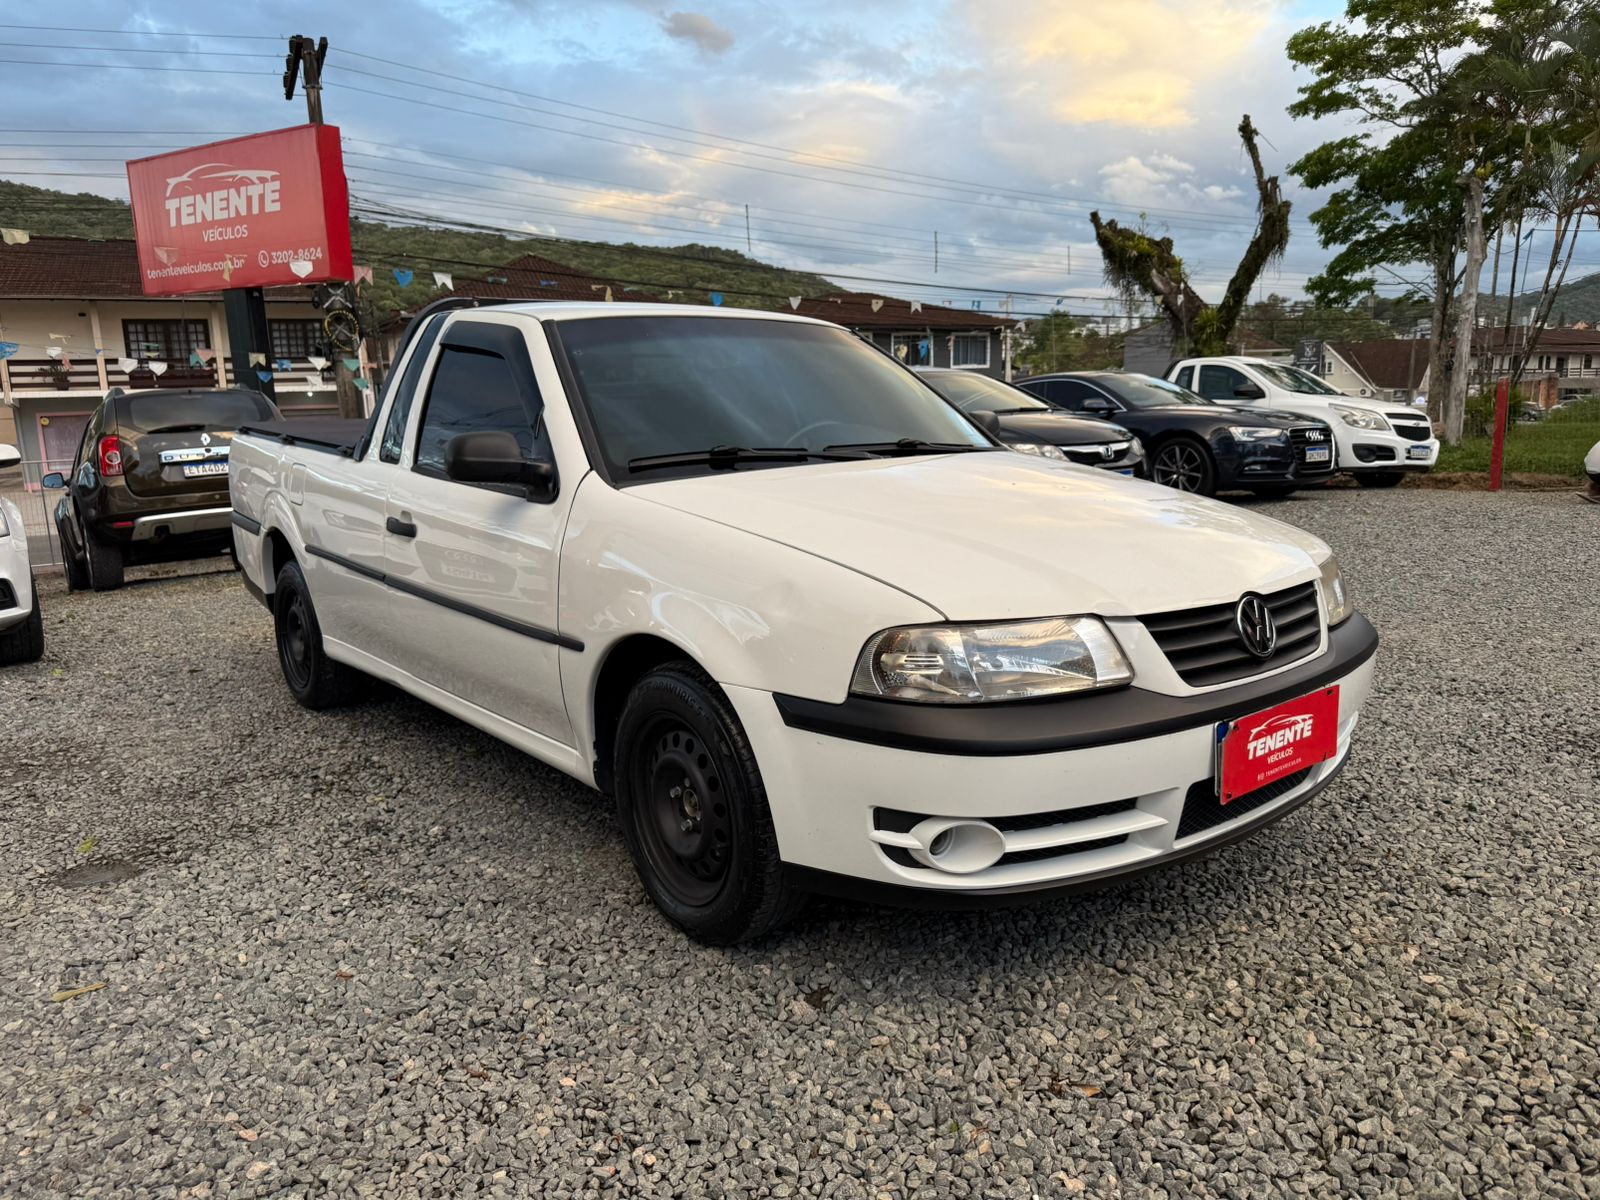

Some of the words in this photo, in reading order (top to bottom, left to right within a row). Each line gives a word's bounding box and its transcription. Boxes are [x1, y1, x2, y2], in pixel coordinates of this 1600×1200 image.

[165, 181, 280, 228] TENENTE
[202, 224, 248, 242] VEÍCULOS
[271, 247, 322, 264] 3202-8624
[1247, 718, 1313, 760] TENENTE
